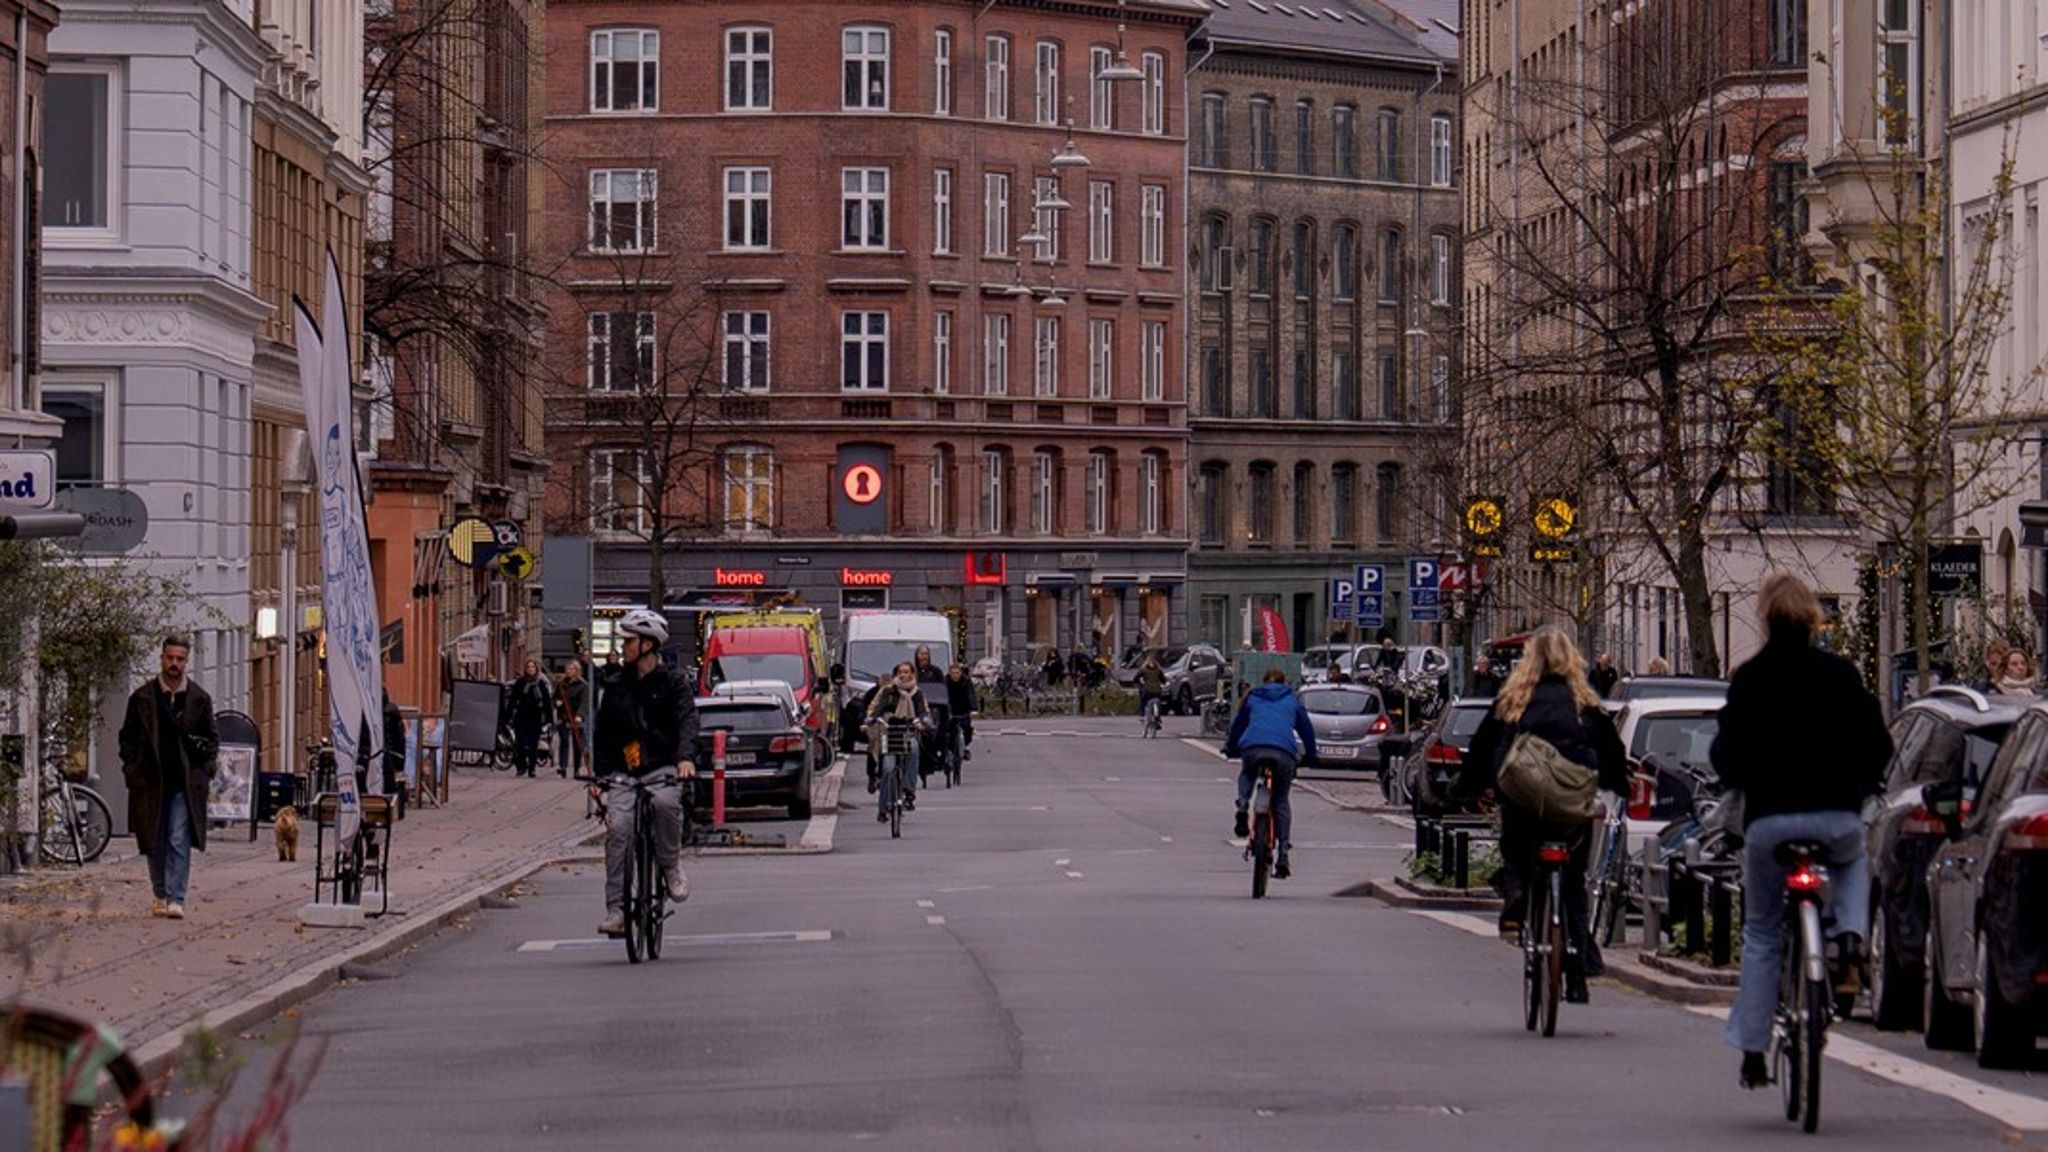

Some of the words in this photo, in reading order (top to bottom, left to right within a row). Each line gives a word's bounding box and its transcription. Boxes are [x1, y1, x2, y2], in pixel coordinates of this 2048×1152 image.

[716, 568, 764, 585] home
[843, 568, 891, 585] home
[1362, 568, 1379, 590] P
[1415, 561, 1434, 586] P
[1337, 581, 1353, 602] P
